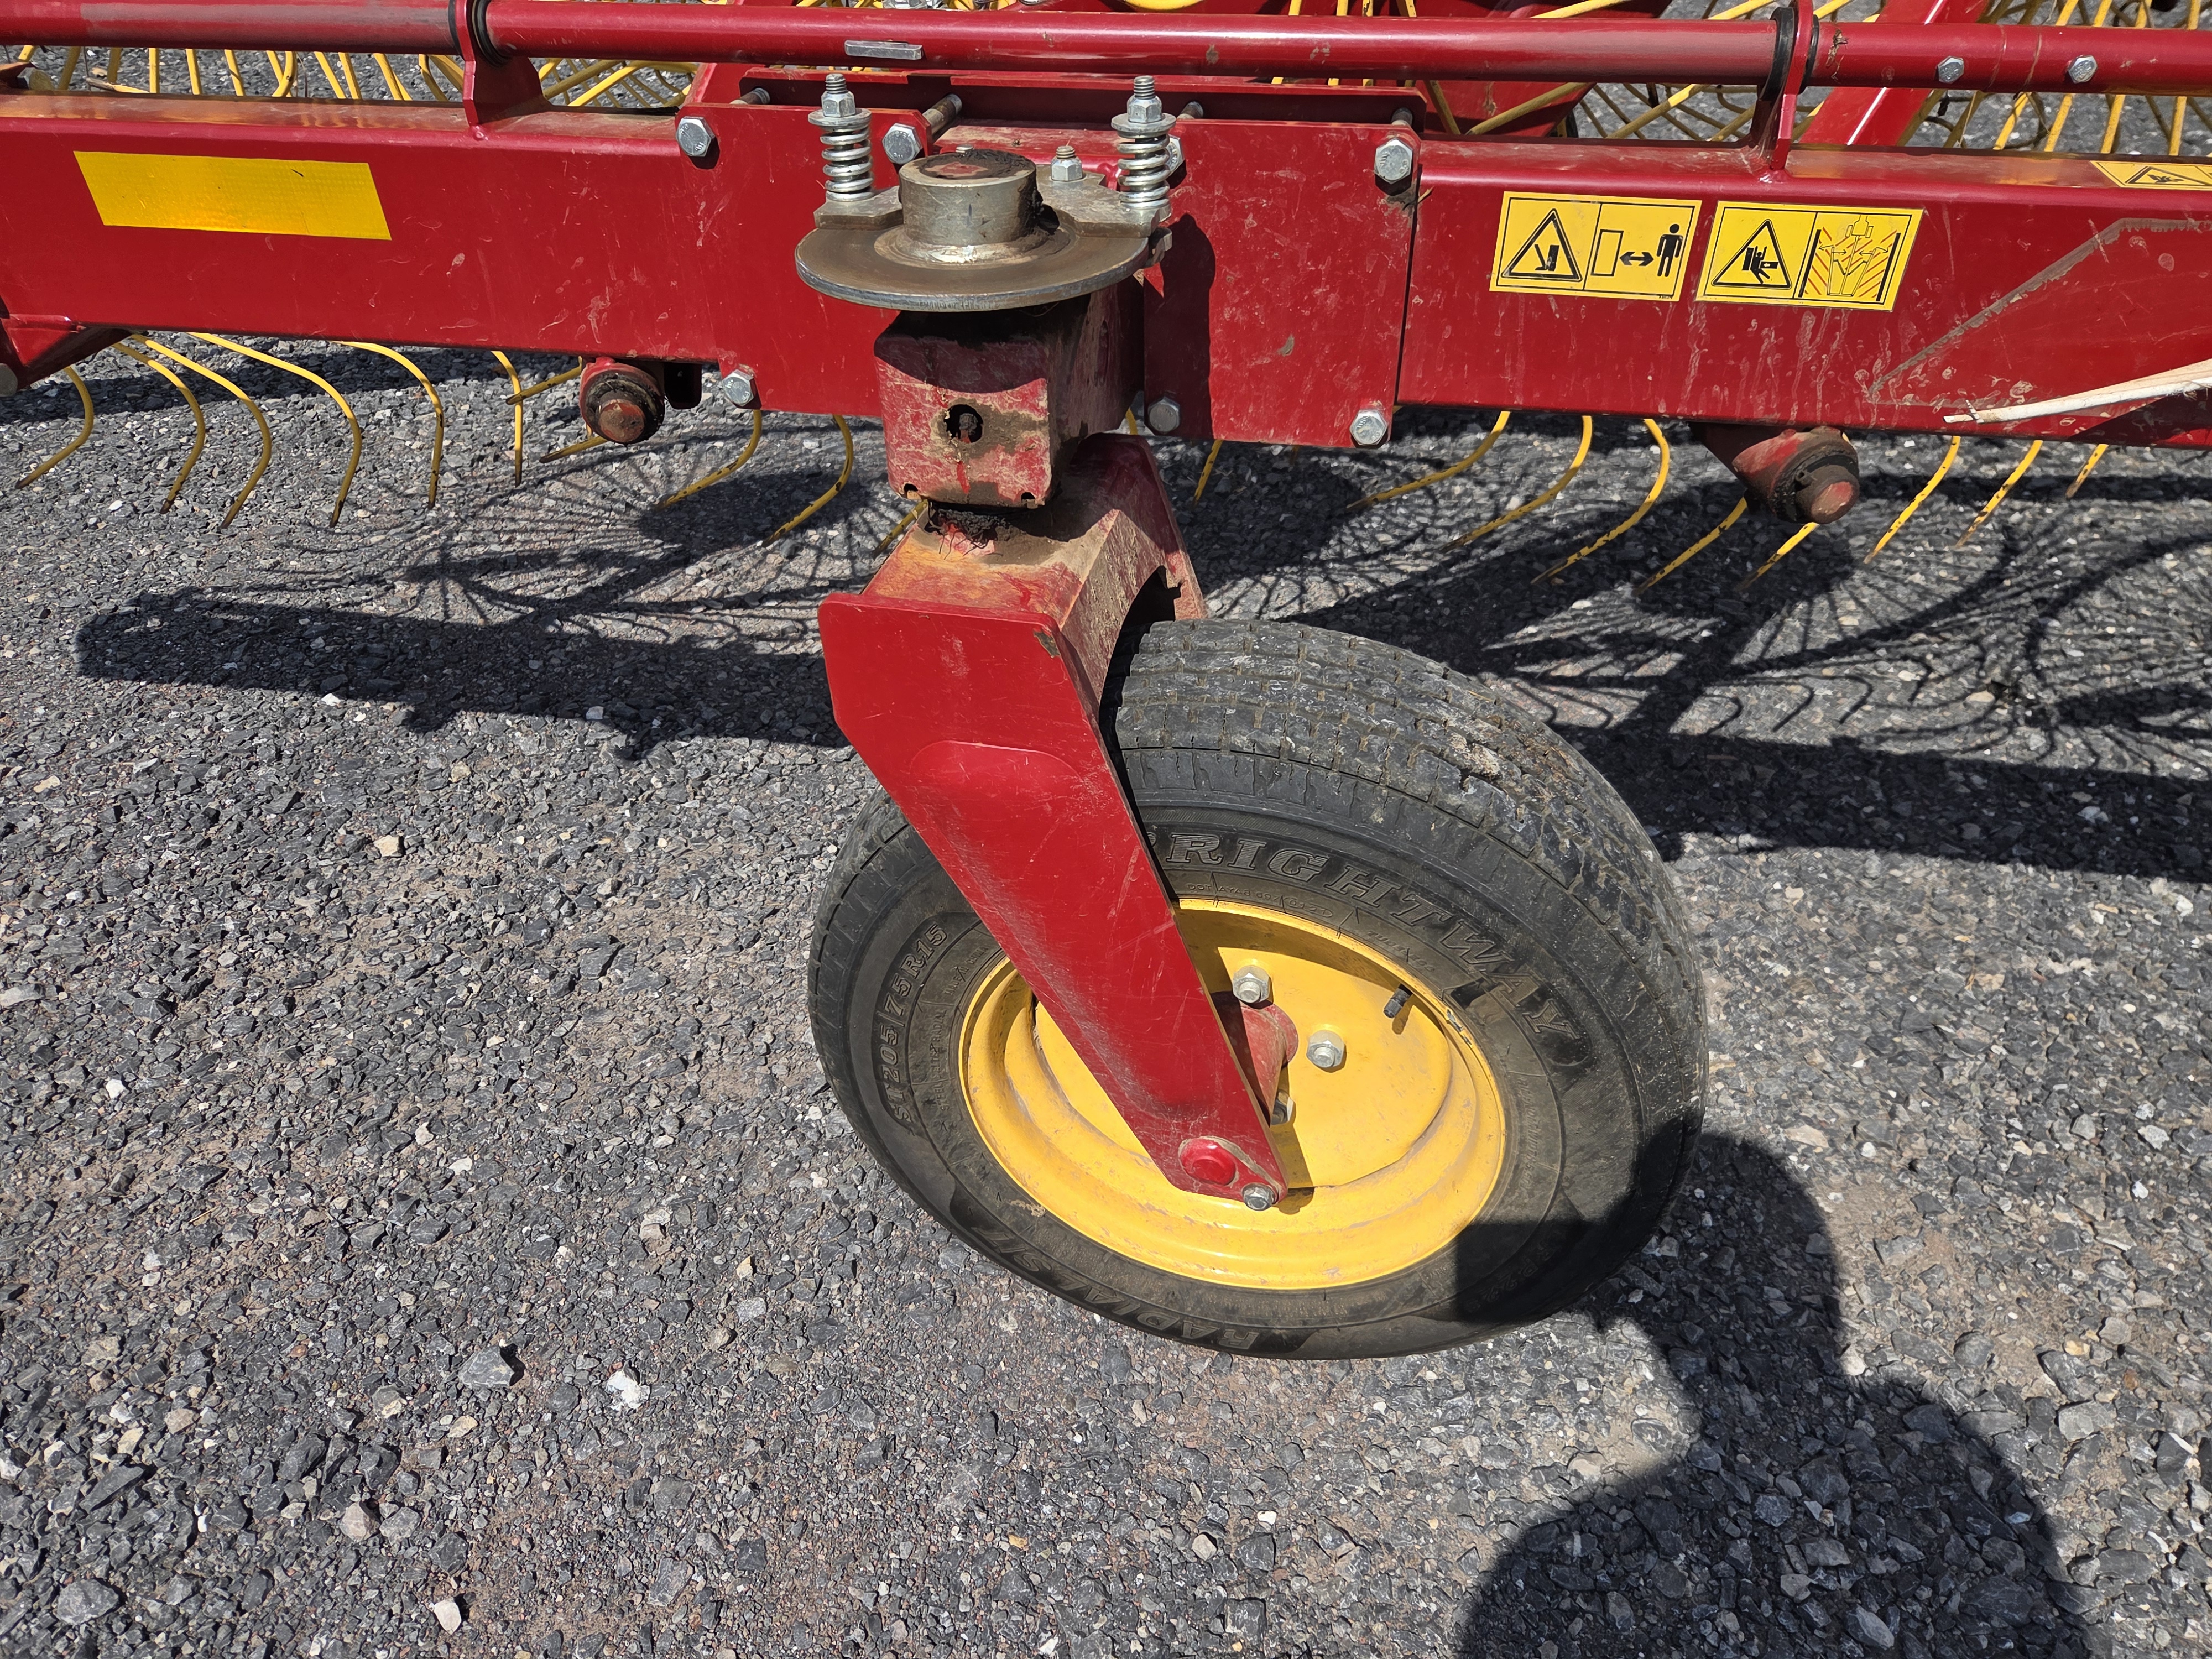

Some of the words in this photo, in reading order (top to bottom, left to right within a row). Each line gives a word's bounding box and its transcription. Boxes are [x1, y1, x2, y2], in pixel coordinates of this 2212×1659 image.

[1187, 884, 1212, 892] DOT
[943, 975, 963, 995] MADE
[965, 945, 989, 965] CHINA
[1147, 832, 1580, 1041] RIGHTWAY
[877, 922, 949, 1124] ST205/75R15
[1057, 1273, 1260, 1350] RADIAL
